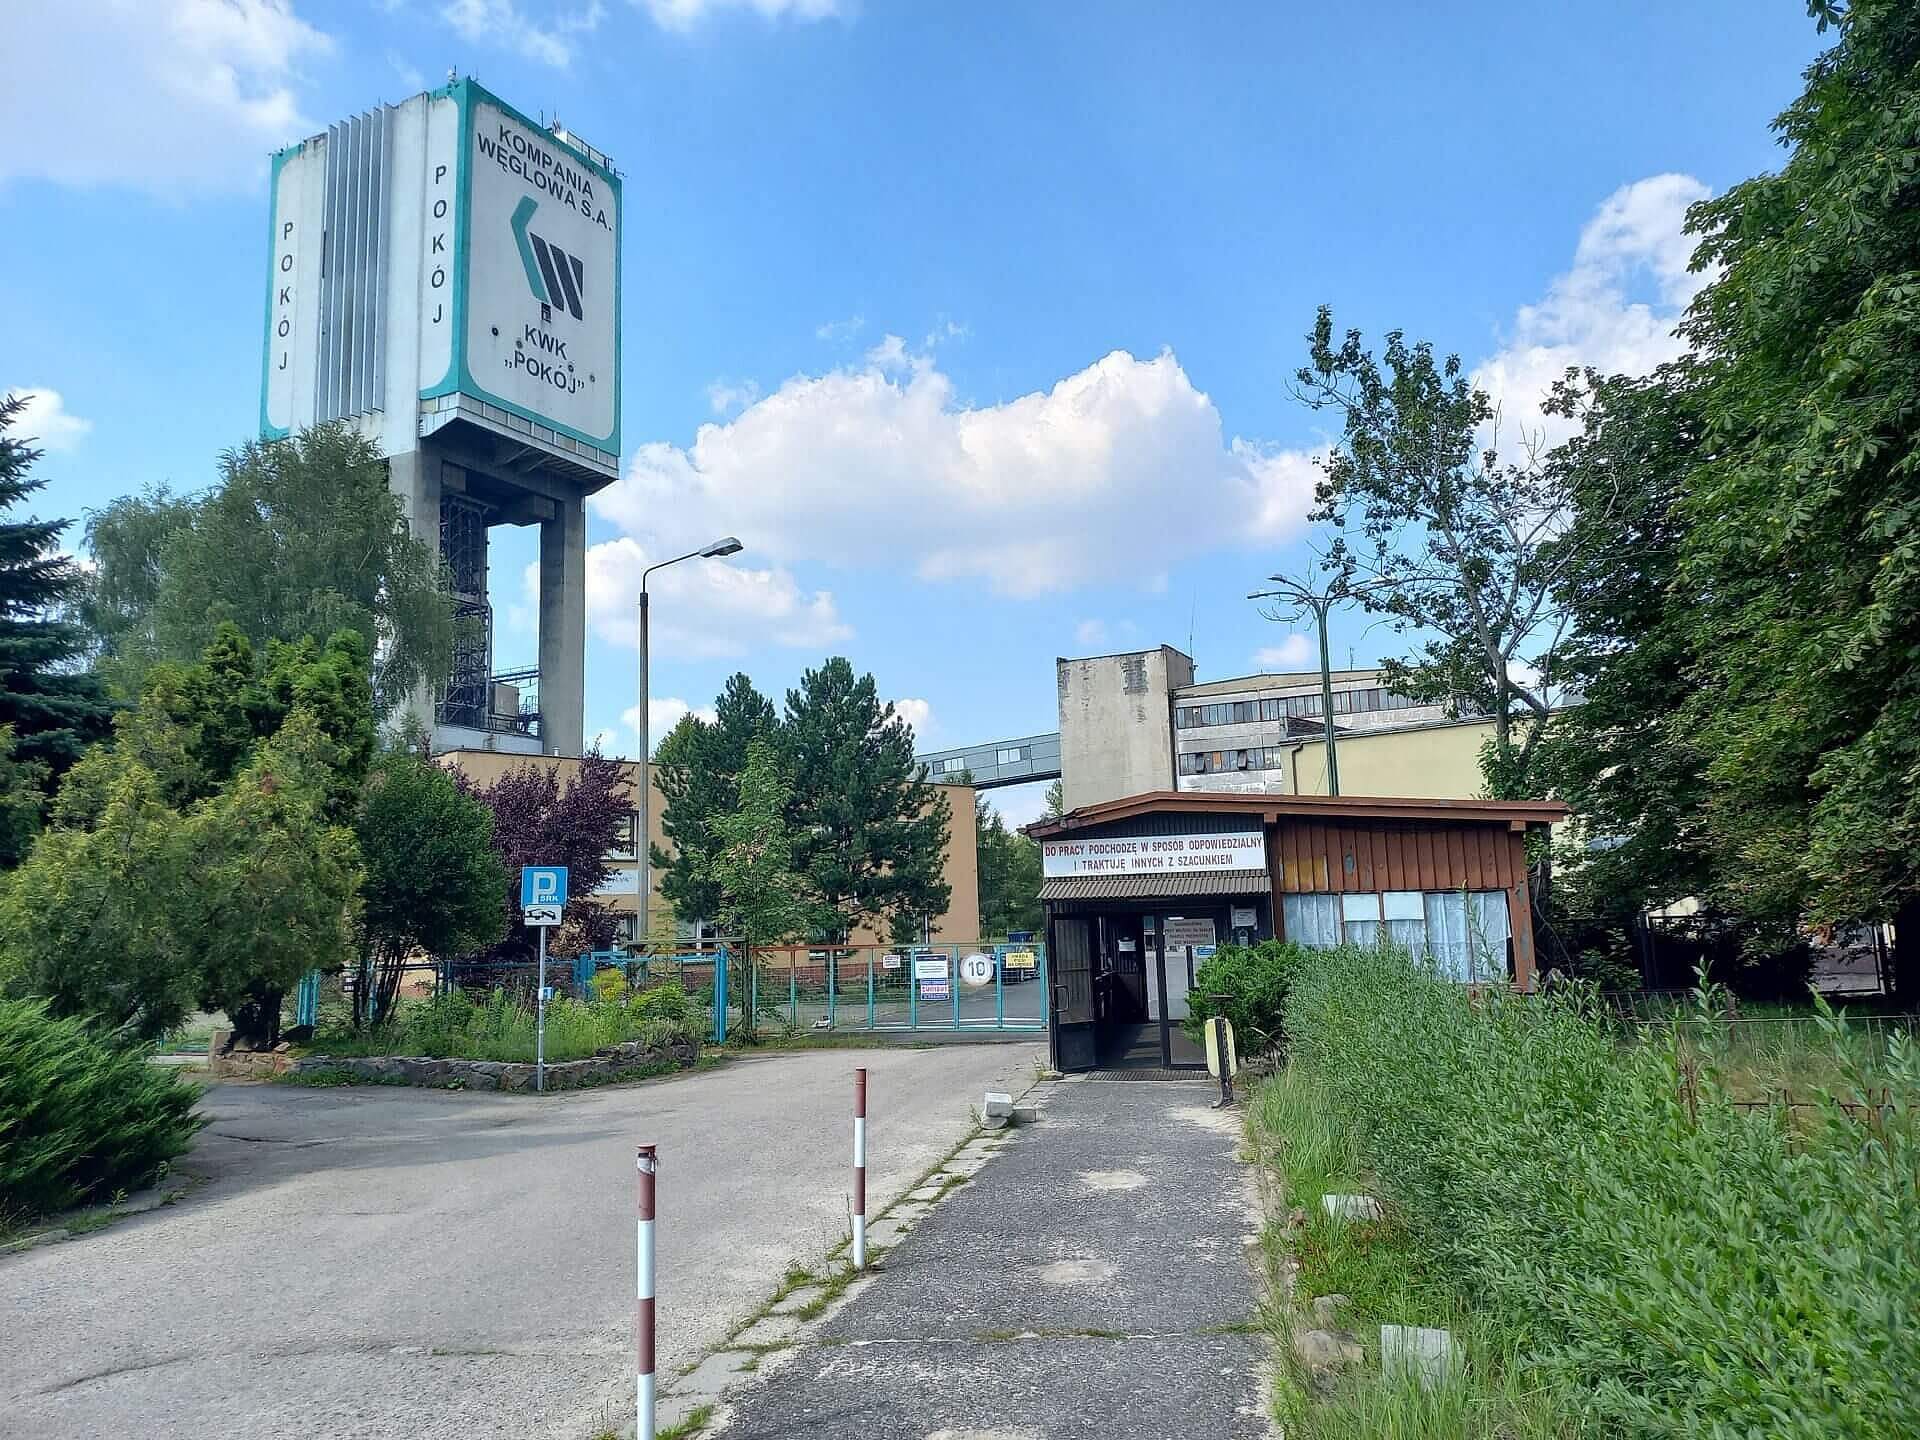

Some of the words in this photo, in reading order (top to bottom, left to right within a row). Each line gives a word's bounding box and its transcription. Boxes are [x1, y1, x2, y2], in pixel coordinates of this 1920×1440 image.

[500, 125, 594, 200] KOMPANIA
[478, 133, 577, 210] WĘGLOWA
[581, 199, 612, 231] S.A.
[431, 165, 447, 323] POKÓJ
[278, 222, 294, 370] POKÓJ
[525, 324, 567, 360] KWK
[1045, 846, 1056, 857] DO
[1059, 844, 1085, 857] PRACY
[1089, 842, 1137, 855] PODCHODZĘ
[1140, 841, 1149, 853] W
[1152, 839, 1184, 852] SPOSÓB
[1188, 836, 1262, 850] ODPOWIEDZIALNY
[1082, 858, 1126, 871] TRAKTUJĘ
[1131, 856, 1164, 869] INNYCH
[1168, 856, 1174, 867] Z
[1178, 854, 1233, 867] SZACUNKIEM
[532, 871, 557, 904] P
[968, 961, 985, 976] 10
